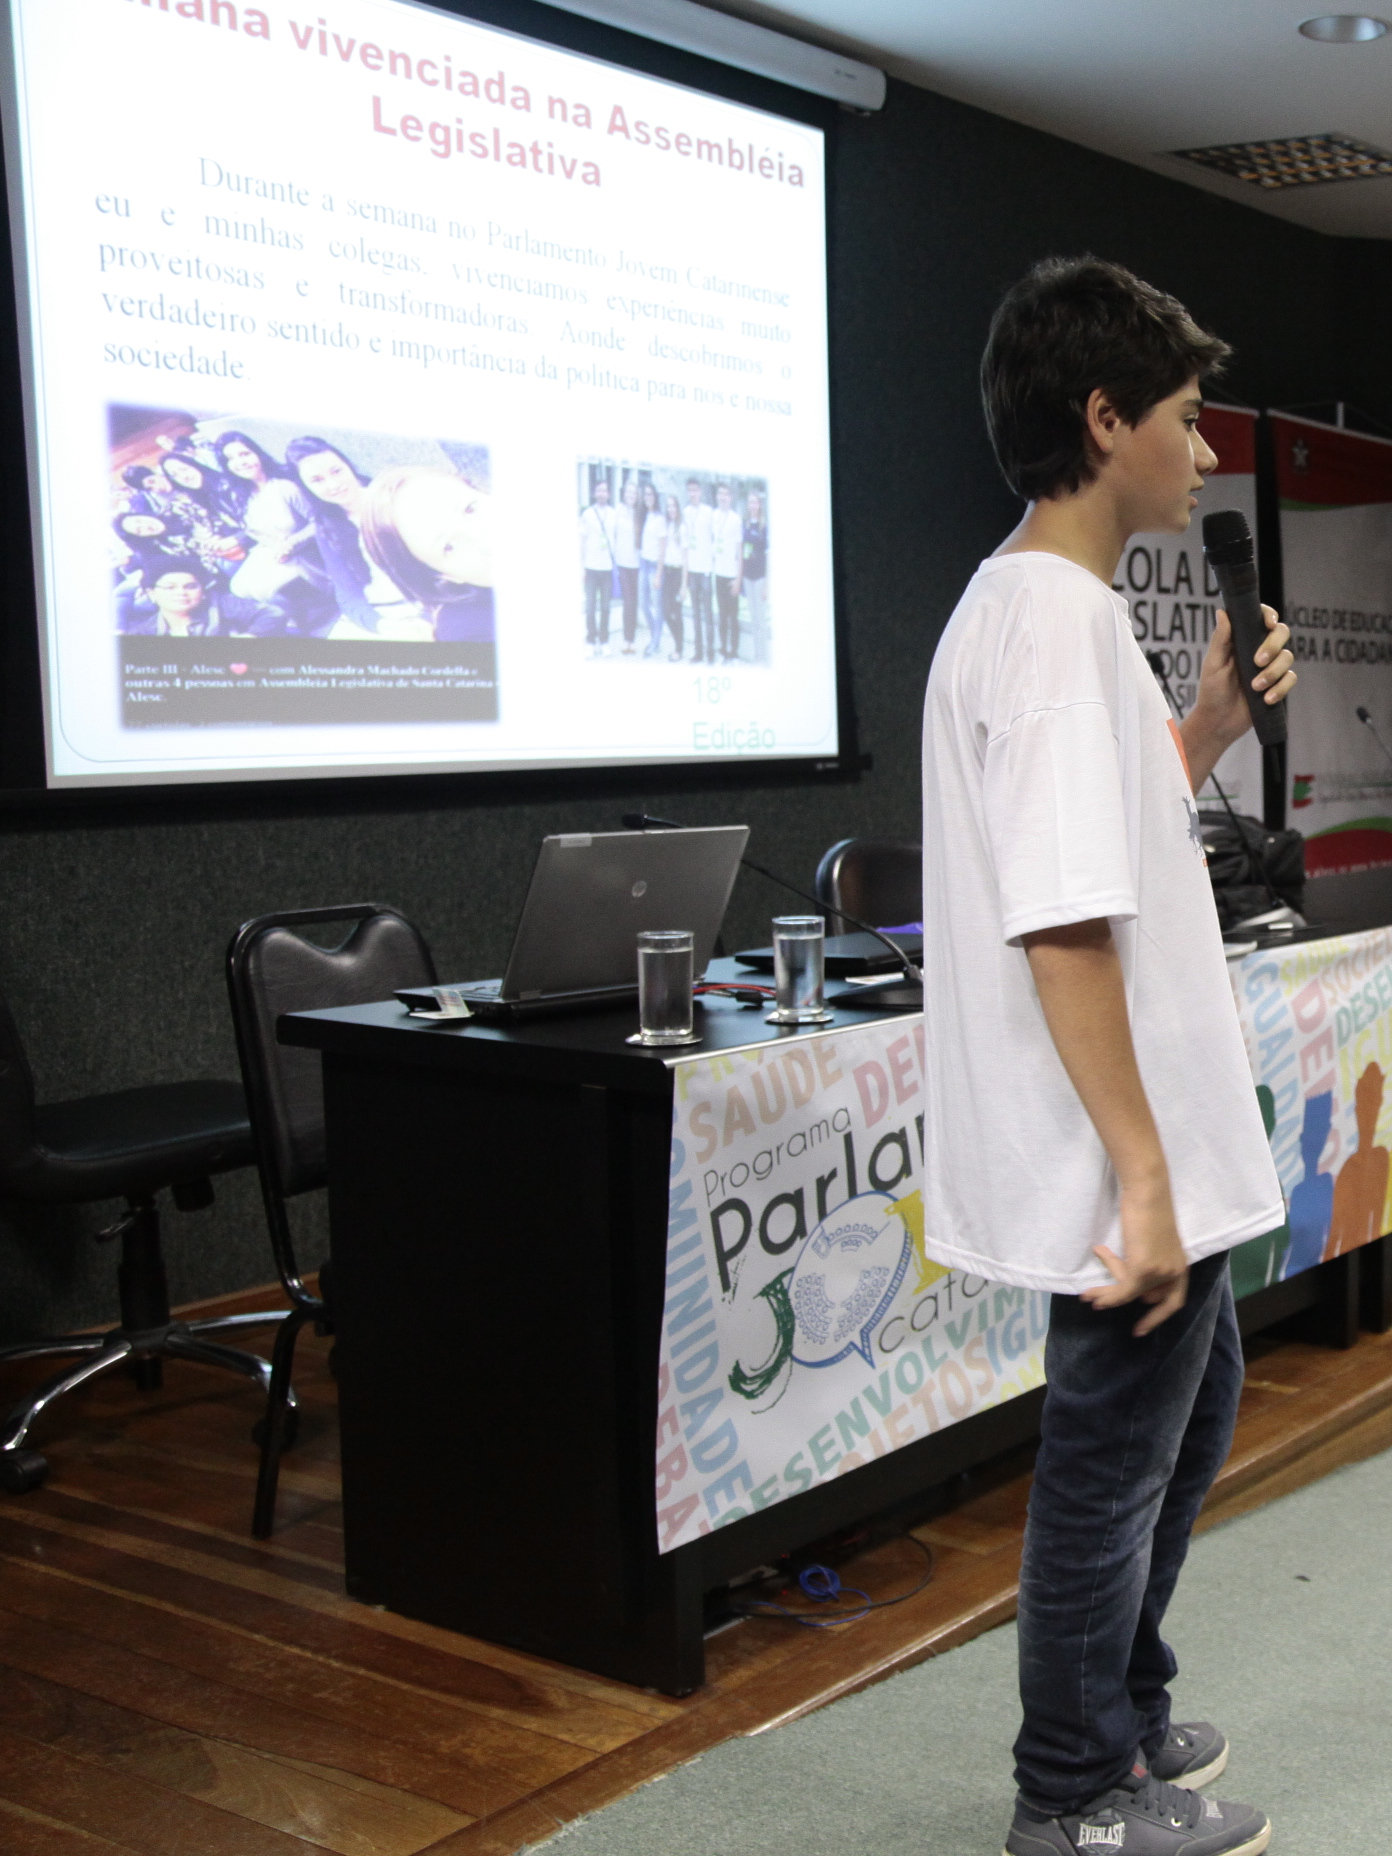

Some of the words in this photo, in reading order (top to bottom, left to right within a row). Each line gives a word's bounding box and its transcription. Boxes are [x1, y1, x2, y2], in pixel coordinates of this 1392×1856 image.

[288, 17, 532, 113] vivenciada
[547, 94, 593, 129] na
[606, 103, 805, 188] Assembléia
[372, 94, 602, 188] Legislativa
[95, 192, 132, 218] eu
[161, 205, 177, 227] e
[204, 211, 305, 252] minhas
[451, 258, 589, 305] vivenciamos
[740, 315, 792, 344] muito
[198, 155, 310, 207] Durante
[321, 191, 336, 212] a
[346, 197, 438, 235] semana
[448, 219, 477, 241] no
[486, 219, 607, 269] Parlamento
[616, 249, 679, 285] Jovem
[686, 265, 791, 309] Catarinense
[98, 242, 266, 291] proveitosas
[295, 277, 310, 298] e
[559, 318, 626, 353] Aonde
[647, 334, 764, 376] descobrimos
[780, 364, 793, 381] o
[101, 291, 257, 336] verdadeiro
[266, 318, 361, 350] sentido
[368, 332, 383, 354] e
[391, 328, 527, 376] importância
[534, 355, 559, 380] da
[646, 377, 687, 402] para
[729, 391, 740, 408] e
[744, 391, 793, 417] nossa
[125, 663, 159, 675] Parte
[692, 721, 777, 755] Edição
[852, 1024, 925, 1129] DE
[702, 1106, 853, 1208] Programa
[708, 1111, 925, 1295] parla
[878, 1272, 989, 1354] cata
[1077, 1822, 1126, 1847] EVERLAST
